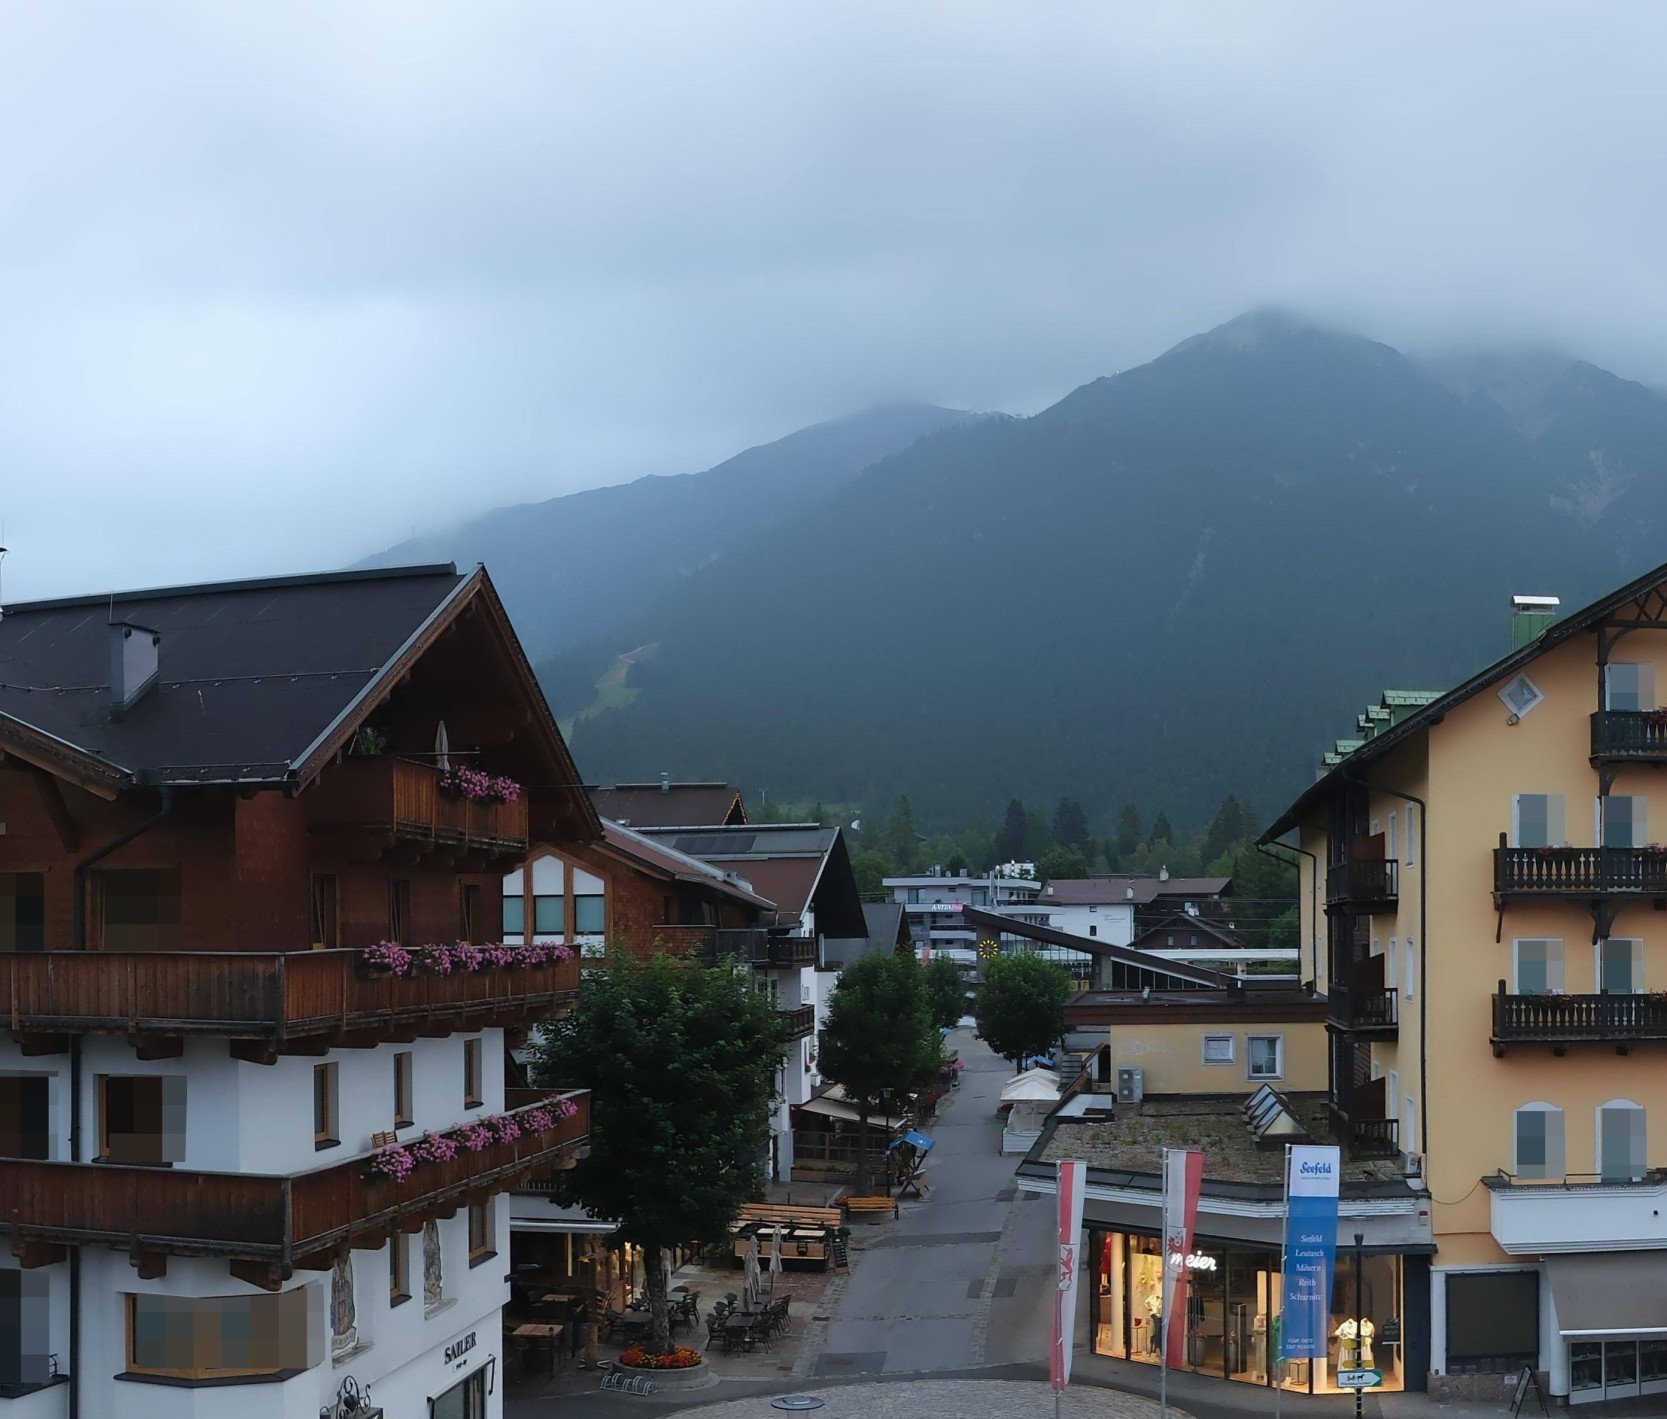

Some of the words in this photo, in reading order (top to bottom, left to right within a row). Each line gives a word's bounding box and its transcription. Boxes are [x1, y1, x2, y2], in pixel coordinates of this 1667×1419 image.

[1300, 1162, 1332, 1174] Seefeld
[1170, 1250, 1217, 1271] meier
[444, 1331, 477, 1365] SAILER
